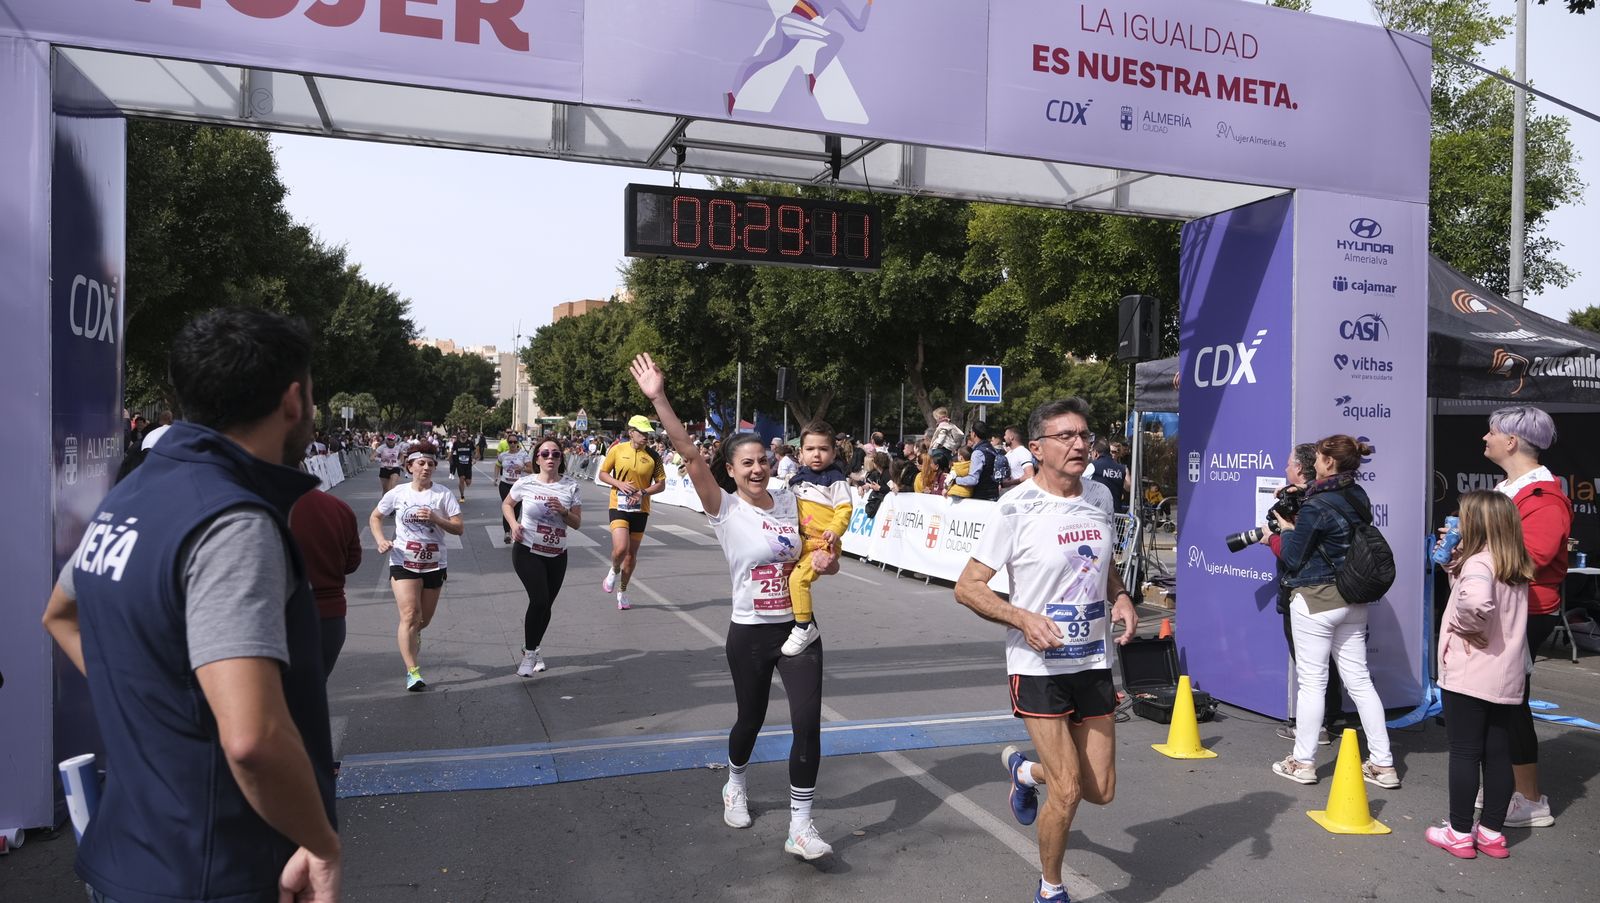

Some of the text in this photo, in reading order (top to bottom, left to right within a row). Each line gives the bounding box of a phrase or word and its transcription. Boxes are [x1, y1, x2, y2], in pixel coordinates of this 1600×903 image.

[1081, 4, 1259, 60] LA IGUALDAD
[1032, 43, 1298, 110] ES NUESTRA META.
[1045, 99, 1093, 126] CDX
[1142, 109, 1192, 129] ALMERÍA
[1142, 123, 1169, 134] CIUDAD
[672, 195, 870, 259] 00:29:11
[1337, 239, 1394, 255] HYUNDAI
[1343, 252, 1388, 266] Almerialva
[1351, 279, 1397, 294] cajamar
[69, 274, 119, 344] CDX
[1193, 329, 1268, 388] CDX
[1352, 356, 1393, 372] vithas
[1342, 403, 1391, 421] aqualia
[1210, 449, 1274, 471] ALMERÍA
[1209, 470, 1240, 482] CIUDAD
[1058, 523, 1083, 532] CARRERA
[542, 534, 560, 545] 953
[1057, 529, 1102, 545] MUJER
[945, 538, 972, 554] CIUDAD
[413, 550, 433, 560] 788
[760, 578, 788, 594] 252
[1067, 621, 1090, 638] 93
